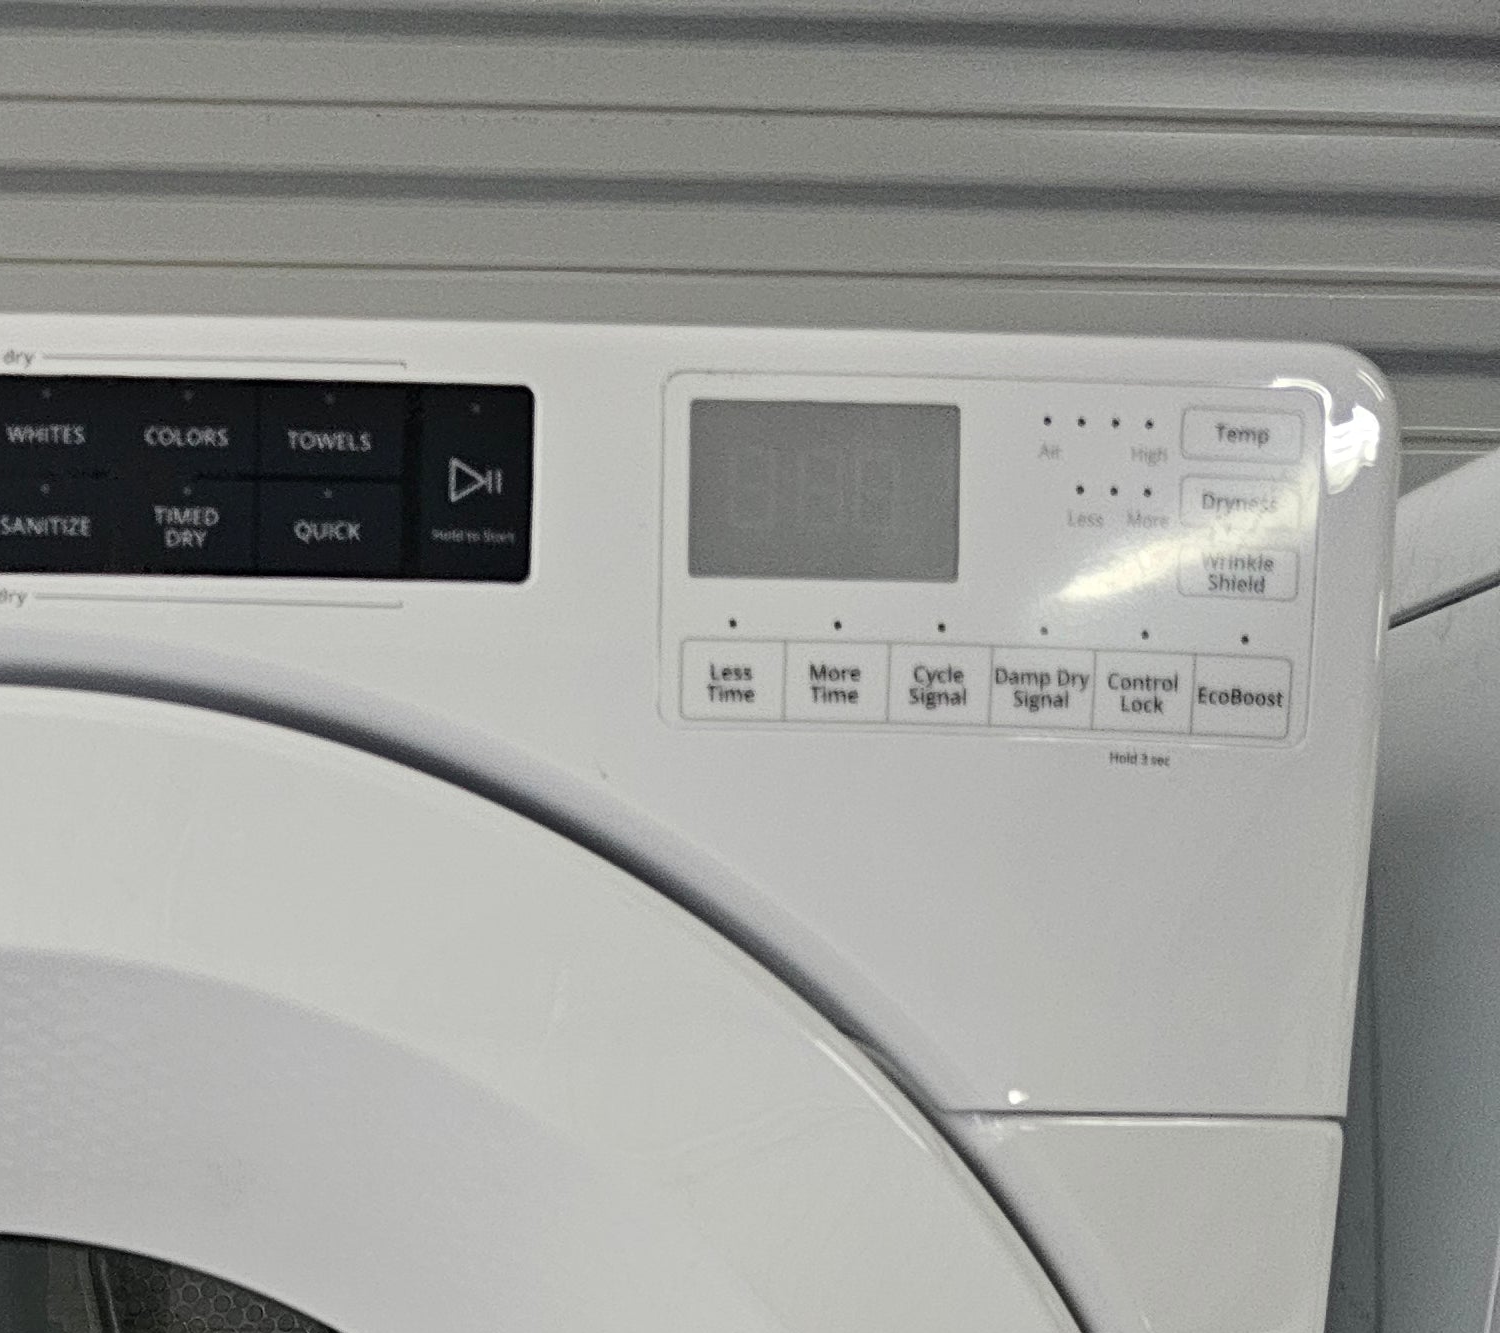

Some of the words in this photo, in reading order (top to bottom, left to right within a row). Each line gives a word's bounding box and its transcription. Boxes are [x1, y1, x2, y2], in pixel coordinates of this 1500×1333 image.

[3, 350, 34, 367] dry
[6, 424, 86, 445] WHITES
[143, 425, 229, 448] COLORS
[288, 430, 372, 453] TOWELS
[1215, 422, 1270, 448] Temp
[1130, 446, 1168, 466] High
[1202, 491, 1277, 518] Dryness
[0, 516, 90, 538] SANITIZE
[153, 506, 219, 528] TIMED
[1067, 510, 1104, 528] Less
[1127, 511, 1170, 529] More
[164, 528, 206, 549] DRY
[293, 520, 362, 543] QUICK
[1202, 551, 1274, 573] Wrinkle
[1208, 573, 1266, 594] Shield
[709, 662, 753, 682] Less
[809, 663, 861, 682] More
[913, 664, 965, 688] Cycle
[995, 667, 1051, 690] Damp
[1057, 668, 1090, 691] Dry
[1107, 671, 1179, 693] Control
[706, 683, 756, 703] Time
[810, 684, 859, 705] Time
[909, 686, 967, 710] Signal
[1013, 689, 1069, 713] Signal
[1120, 693, 1164, 714] Lock
[1198, 686, 1284, 709] EcoBoost
[1109, 751, 1137, 766] Hold
[1150, 755, 1170, 768] sec
